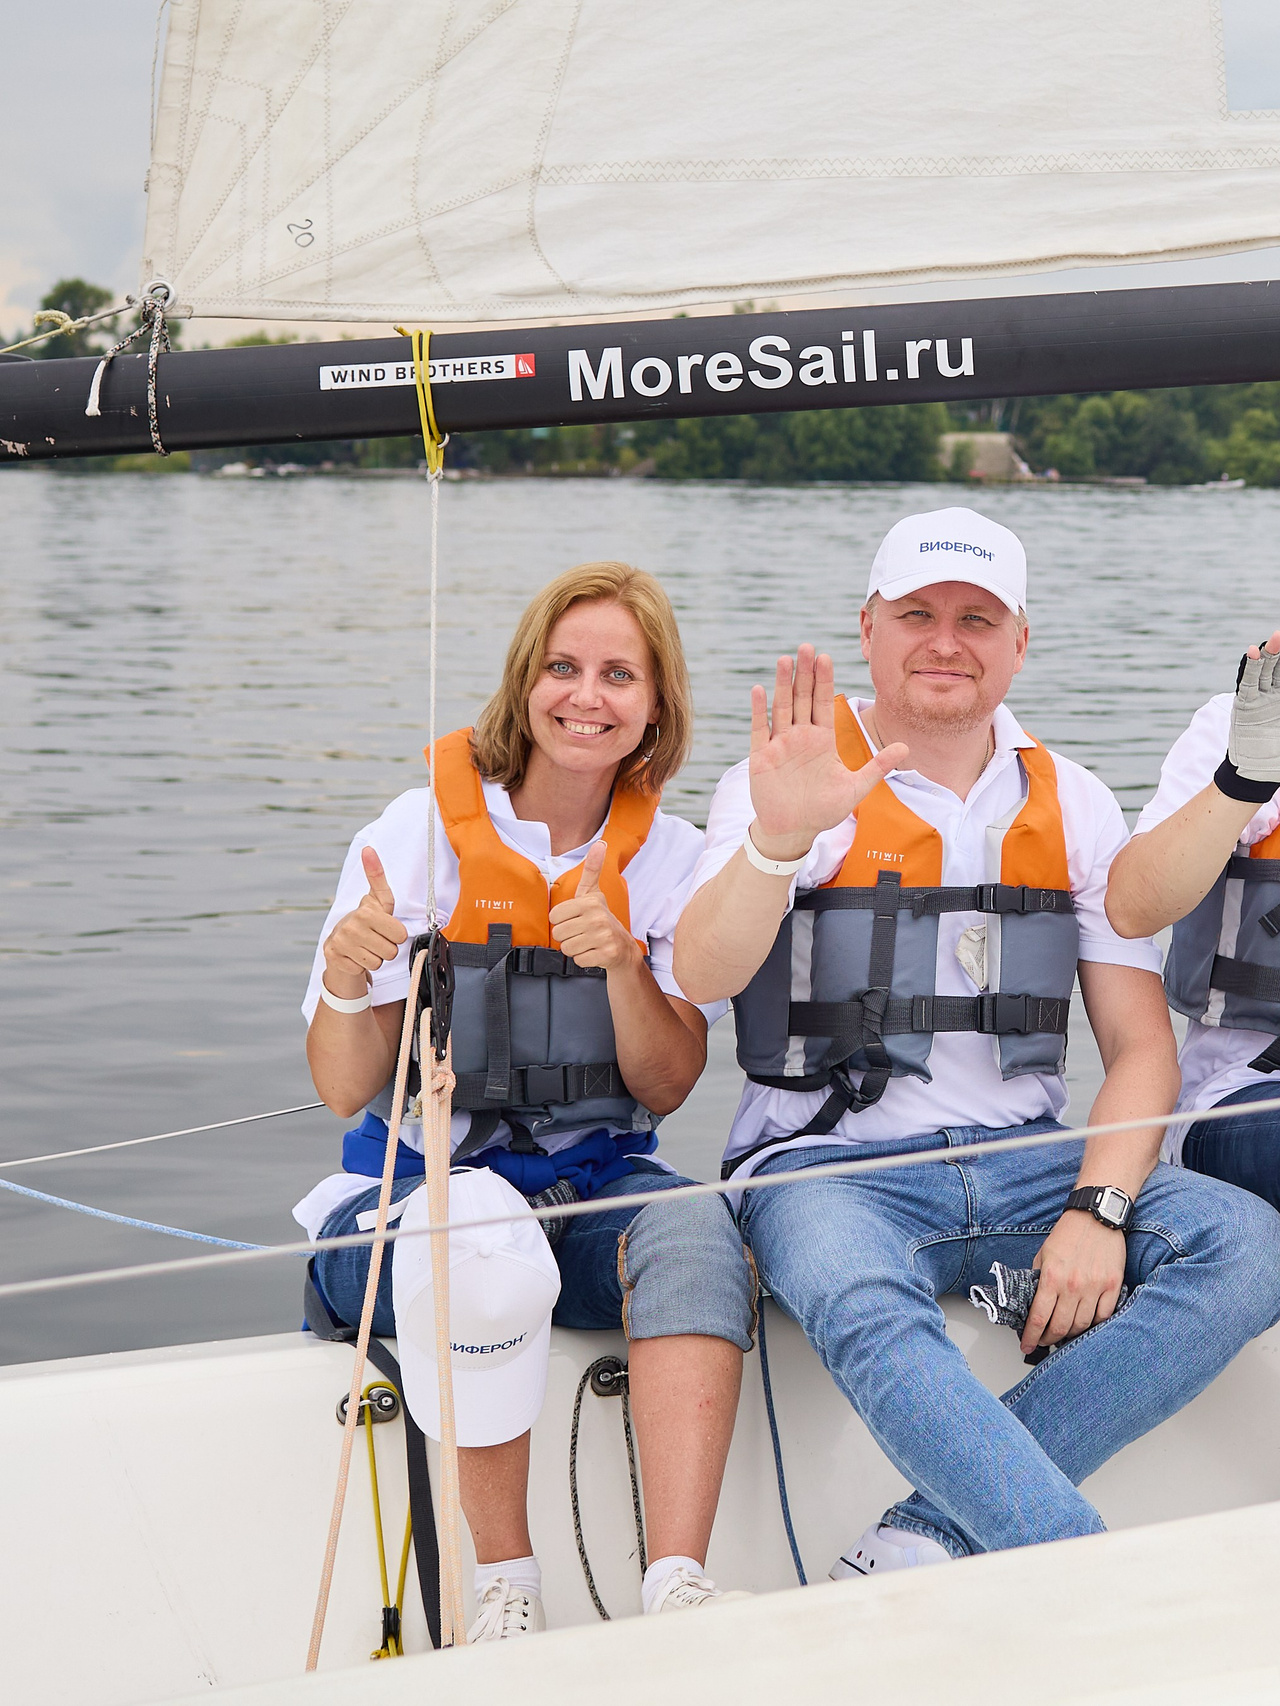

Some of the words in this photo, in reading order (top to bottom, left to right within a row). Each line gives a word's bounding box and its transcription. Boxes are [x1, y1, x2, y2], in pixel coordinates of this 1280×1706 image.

[286, 218, 315, 248] 20
[567, 329, 976, 402] MoreSail.ru
[331, 367, 386, 384] WIND
[866, 849, 905, 863] ITIWIT
[475, 899, 514, 910] ITIWIT
[450, 1334, 524, 1354] ИФЕРОН
